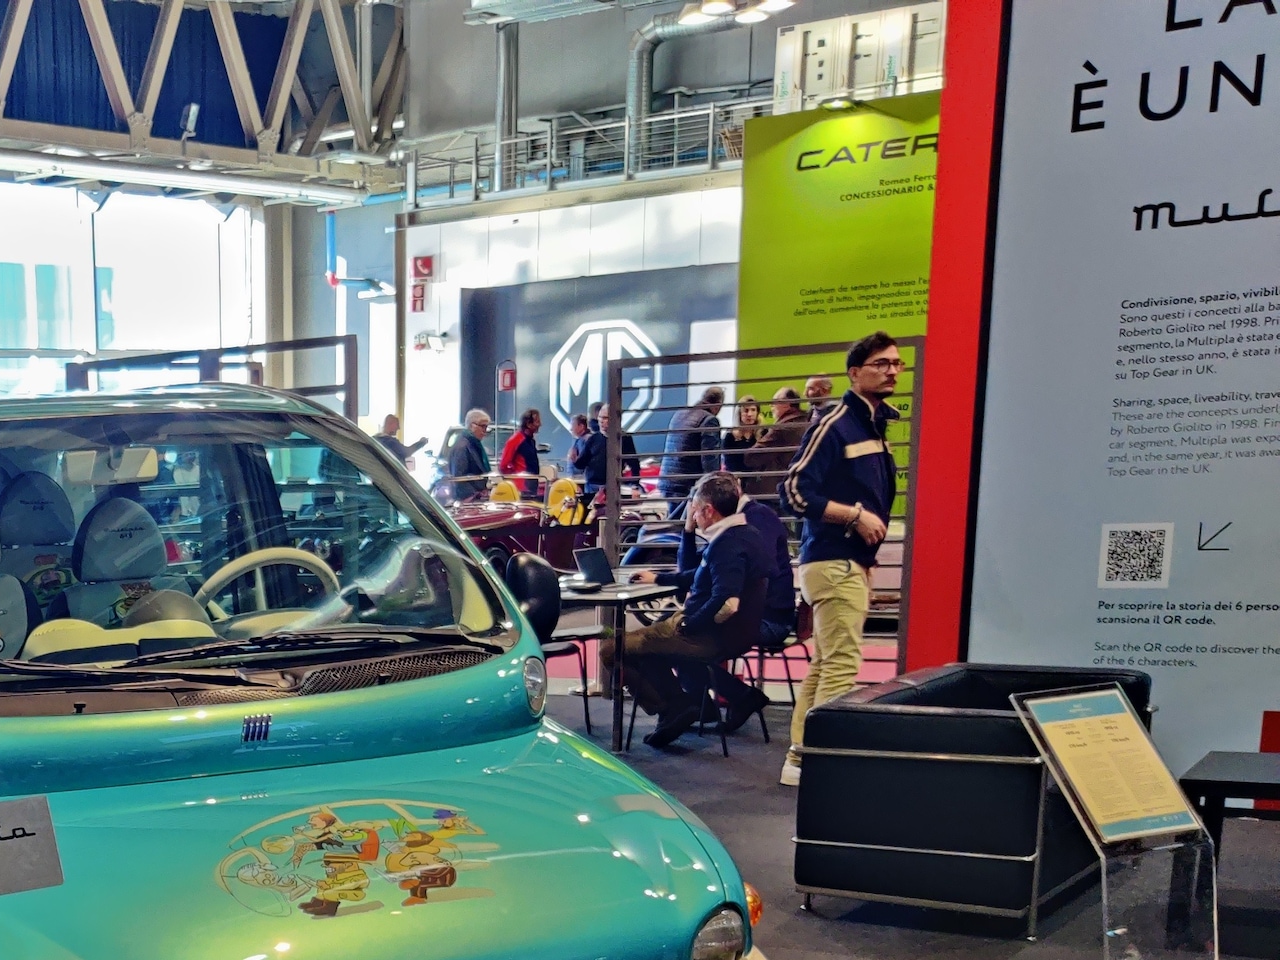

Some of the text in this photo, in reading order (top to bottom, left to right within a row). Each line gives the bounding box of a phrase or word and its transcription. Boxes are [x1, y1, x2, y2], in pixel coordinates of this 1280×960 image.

[1071, 59, 1108, 133] È
[839, 184, 925, 202] CONCESSIONARIO
[1121, 286, 1280, 310] Condivisione, spazio, vivibil
[1120, 313, 1148, 324] Sono
[1151, 310, 1185, 323] questi
[1194, 304, 1241, 318] concetti
[1244, 303, 1265, 314] alla
[1119, 327, 1163, 338] Roberto
[1166, 323, 1205, 334] Giolito
[1208, 321, 1226, 331] nel
[1231, 318, 1261, 329] 1998.
[1117, 341, 1174, 353] segmento,
[1175, 339, 1184, 348] la
[1187, 335, 1235, 347] Multipla
[1237, 333, 1243, 343] è
[1246, 333, 1274, 343] stata
[1128, 355, 1157, 365] nello
[1160, 354, 1195, 363] stesso
[1198, 351, 1229, 361] anno,
[1232, 348, 1239, 358] è
[1242, 348, 1271, 357] stata
[1131, 369, 1150, 380] Top
[1153, 367, 1179, 377] Gear
[1182, 365, 1192, 376] in
[1196, 364, 1217, 375] UK.
[1112, 397, 1156, 408] Sharing,
[1158, 397, 1192, 406] space,
[1194, 391, 1252, 404] liveability,
[1112, 404, 1280, 421] These are the concepts underl
[1110, 427, 1123, 437] by
[1127, 425, 1170, 435] Roberto
[1173, 422, 1212, 433] Giolito
[1216, 420, 1226, 430] in
[1109, 442, 1125, 450] car
[1180, 436, 1227, 447] Multipla
[1231, 435, 1252, 444] was
[1133, 454, 1141, 462] in
[1144, 452, 1162, 461] the
[1166, 452, 1194, 461] same
[1225, 449, 1232, 458] it
[1235, 449, 1256, 458] was
[1106, 466, 1127, 477] Top
[1129, 466, 1156, 476] Gear
[1158, 465, 1168, 474] in
[1170, 464, 1189, 474] the
[1098, 600, 1115, 610] Per
[1118, 601, 1163, 612] scoprire
[1166, 601, 1176, 610] la
[1179, 601, 1211, 611] storia
[1214, 601, 1232, 611] dei
[1235, 601, 1243, 611] 6
[1096, 614, 1216, 625] scansiona il QR code.
[1094, 642, 1120, 652] Scan
[1122, 643, 1141, 652] the
[1143, 643, 1162, 652] QR
[1165, 644, 1193, 653] code
[1195, 645, 1207, 653] to
[1210, 644, 1259, 654] discover
[1092, 655, 1198, 667] of the 6 characters.
